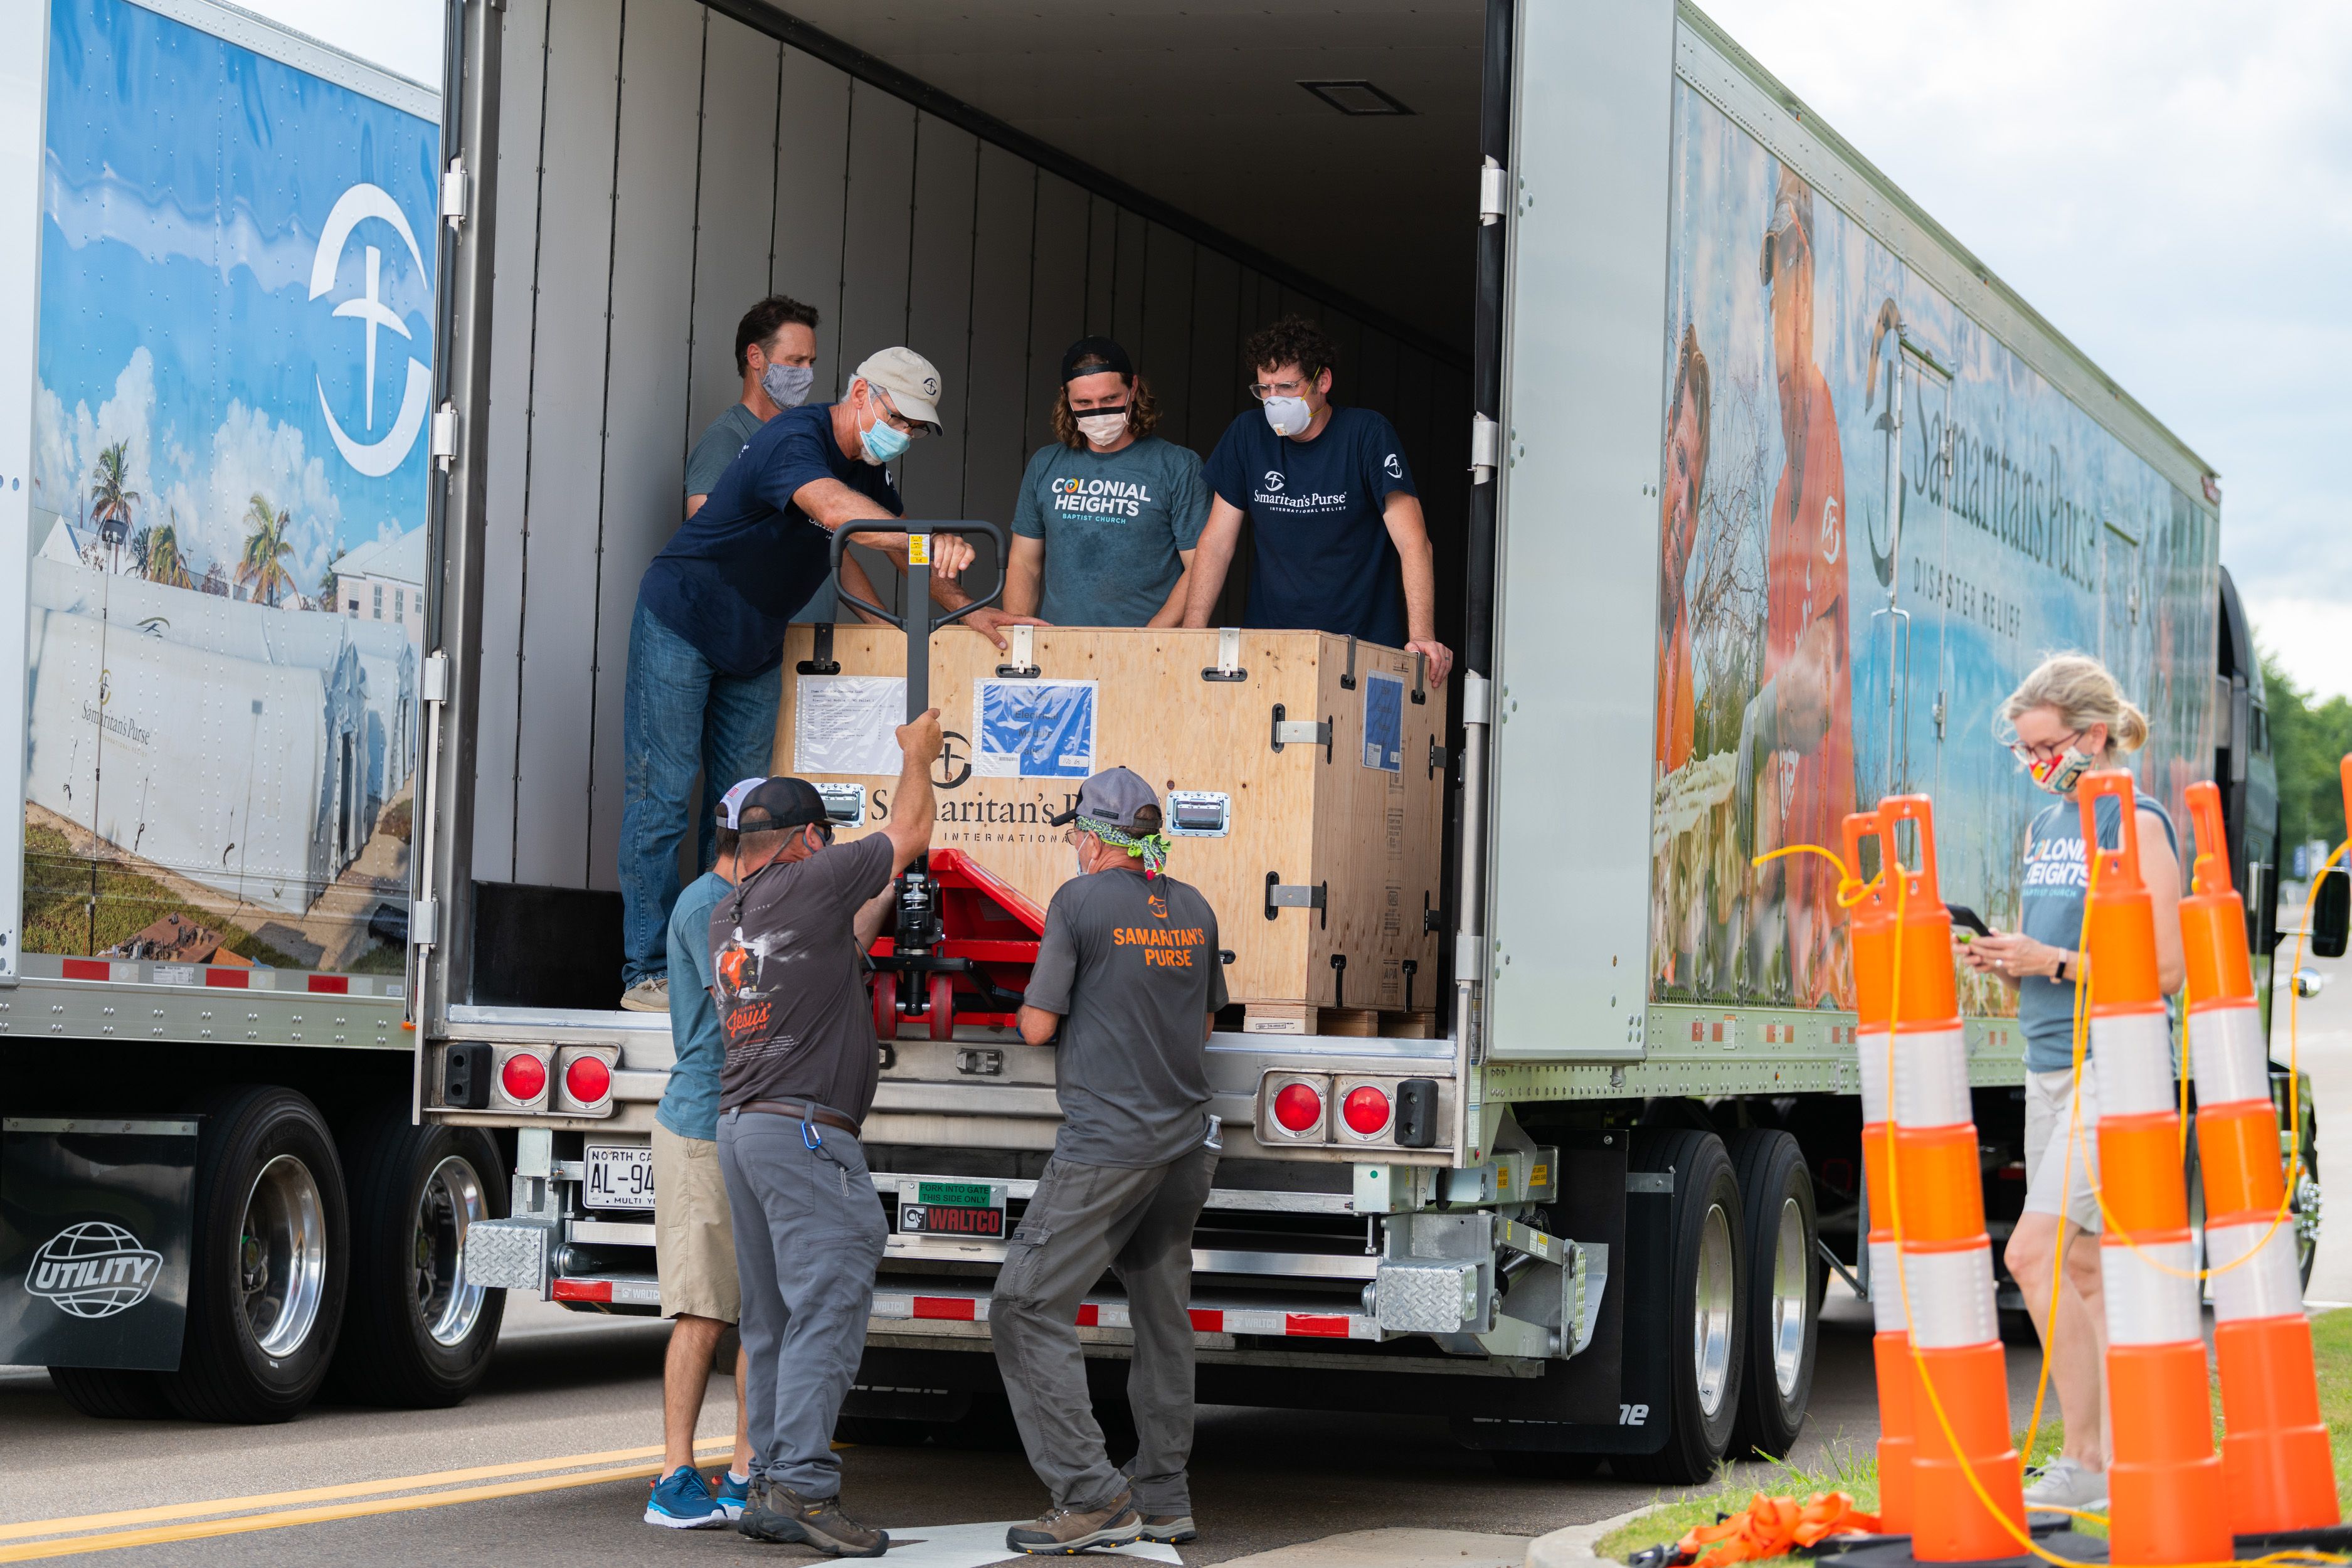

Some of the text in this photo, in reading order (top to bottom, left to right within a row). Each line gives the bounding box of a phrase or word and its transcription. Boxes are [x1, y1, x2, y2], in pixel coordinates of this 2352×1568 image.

[1052, 478, 1151, 502] COLONIAL
[1311, 493, 1345, 506] Purse
[1054, 495, 1139, 516] HEIGHTS
[1062, 513, 1126, 524] BAPTIST CHURCH
[1914, 556, 2021, 641] DISASTER RELIEF
[128, 718, 150, 745] Purse
[871, 789, 1055, 824] Saritan's
[1113, 928, 1205, 946] SAMARITAN'S
[1145, 949, 1192, 966] PURSE
[592, 1151, 633, 1161] NORTH
[928, 1208, 999, 1232] WALTCO
[36, 1257, 154, 1289] UTILITY
[874, 1301, 904, 1311] WALTCO
[1245, 1318, 1276, 1328] WALTCO
